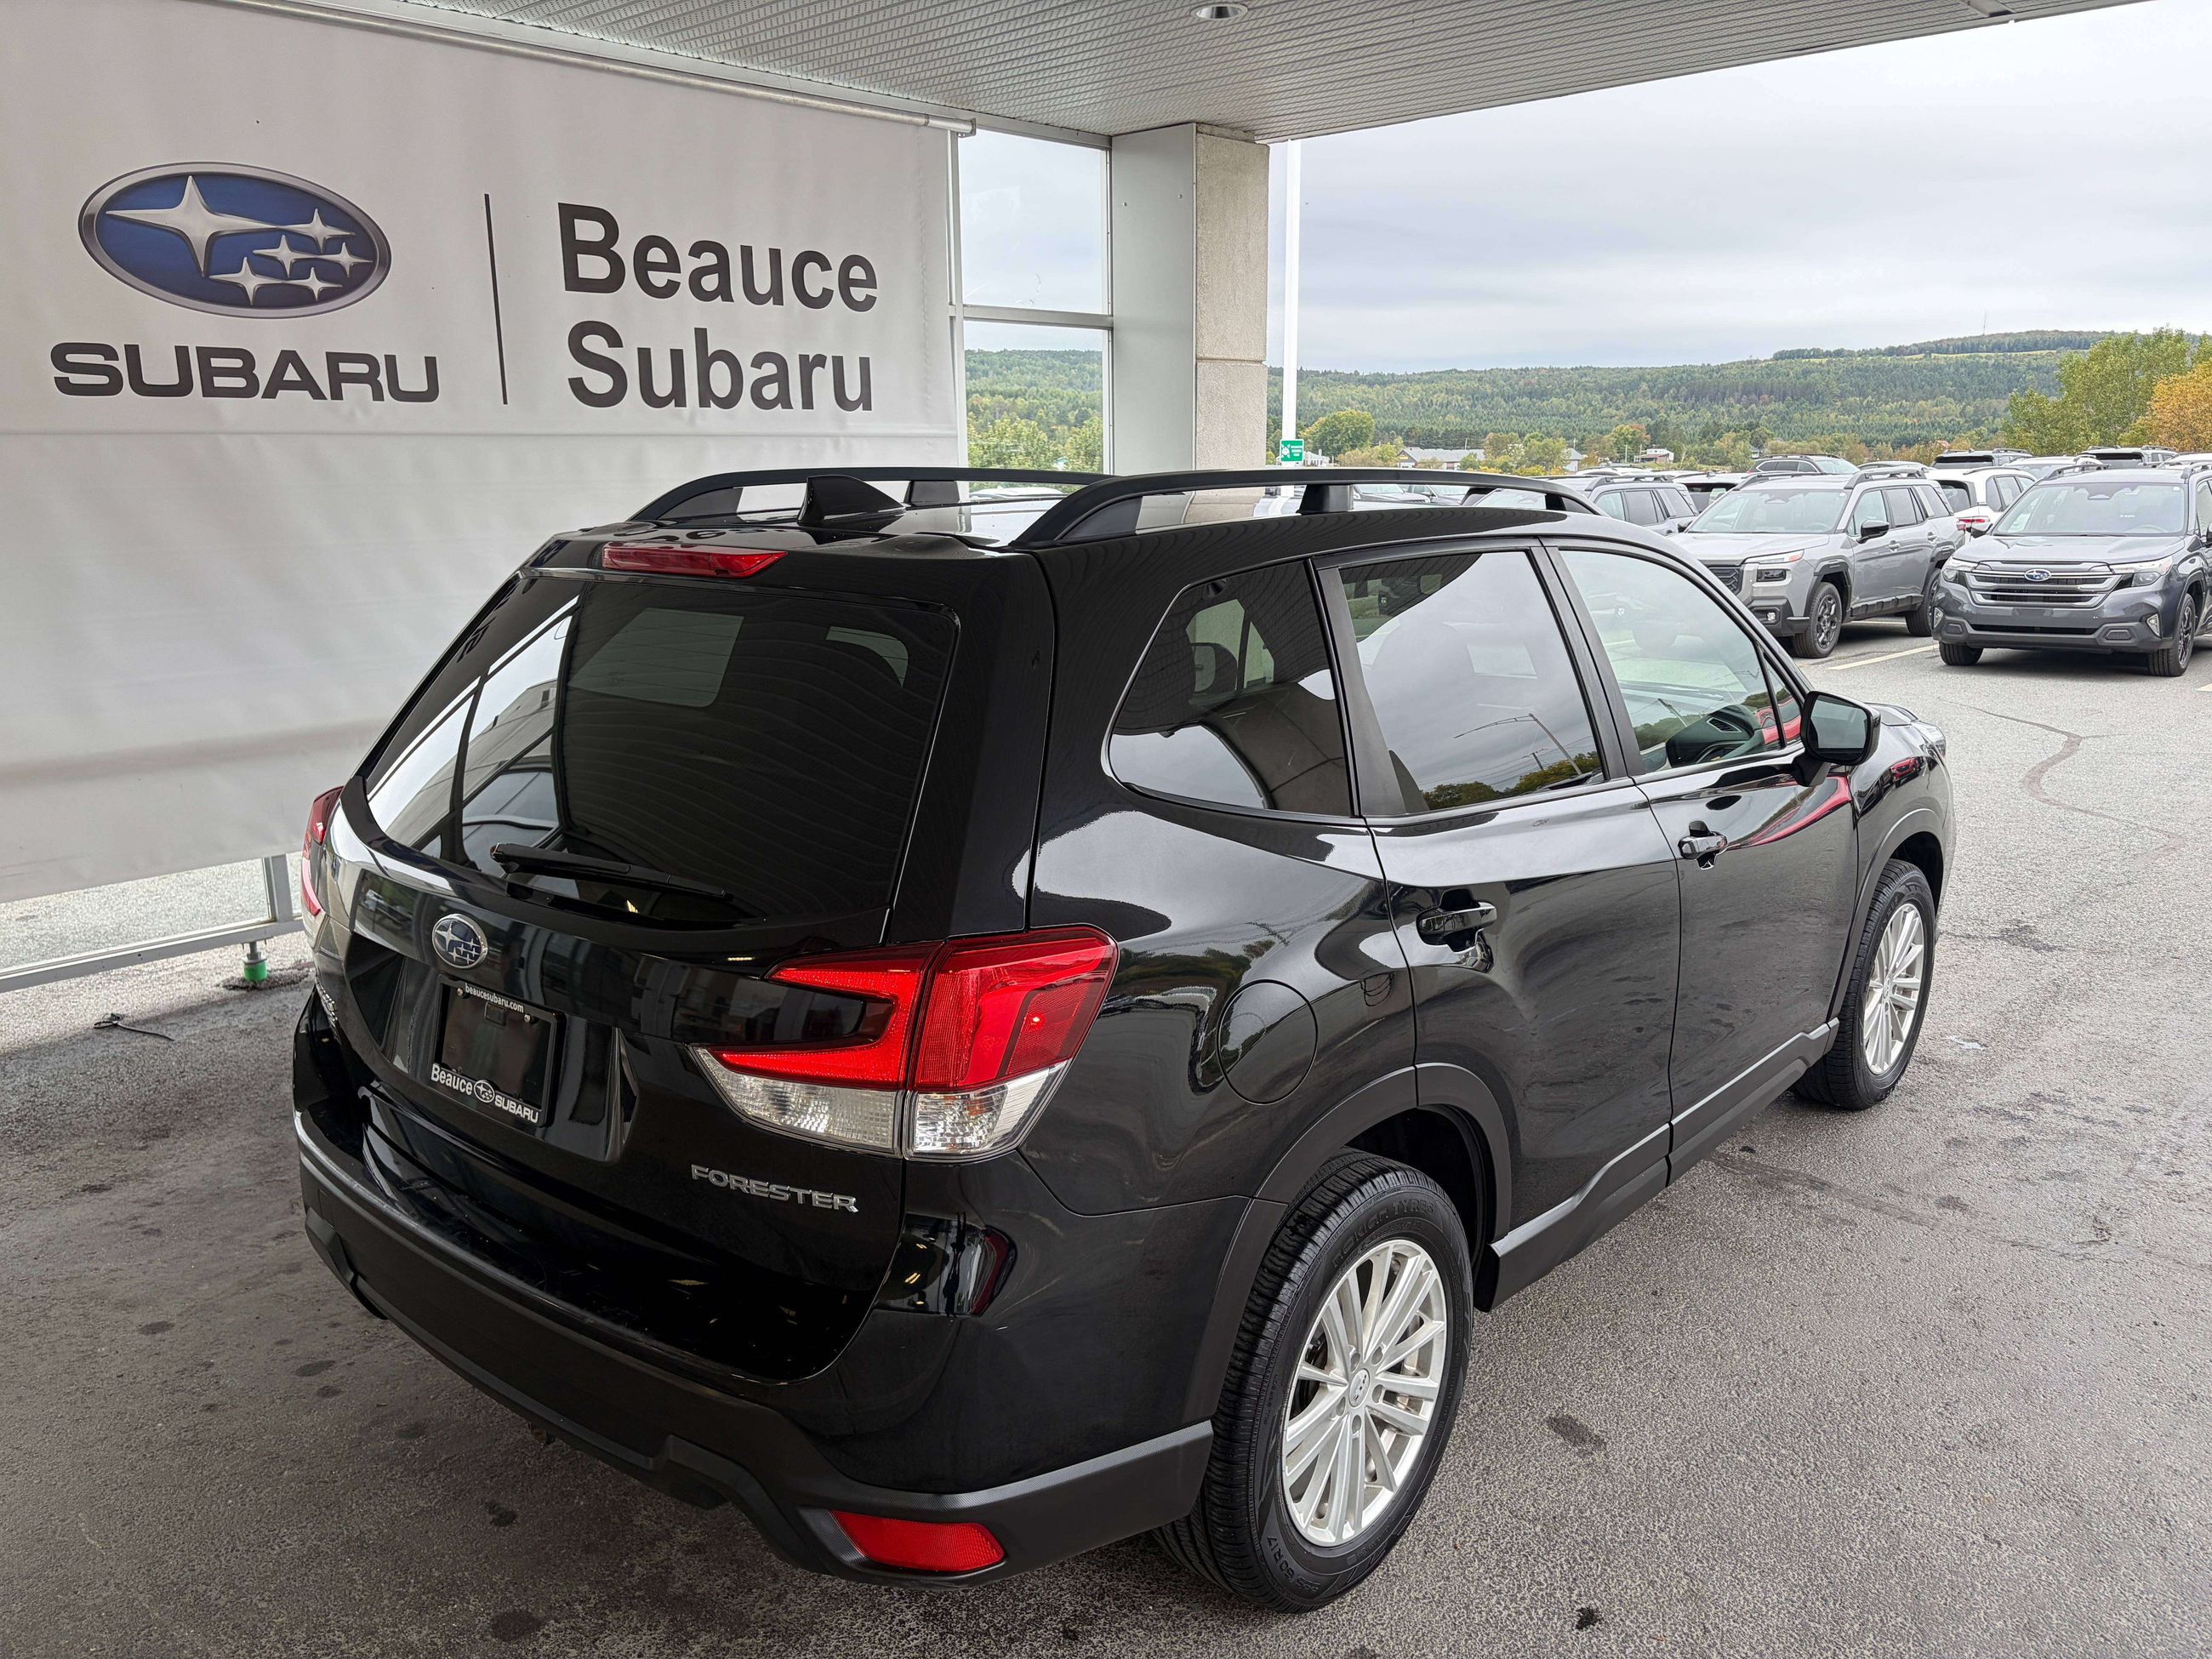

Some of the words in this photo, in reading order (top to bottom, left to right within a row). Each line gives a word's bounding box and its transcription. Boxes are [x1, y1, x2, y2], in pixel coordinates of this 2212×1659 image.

[558, 202, 878, 313] Beauce
[50, 342, 440, 403] SUBARU
[568, 321, 873, 412] Subaru
[465, 982, 525, 1013] beaucesubaru.com
[430, 1063, 473, 1096] Beauce
[494, 1094, 539, 1124] SUBARU
[691, 1164, 859, 1213] FORESTER
